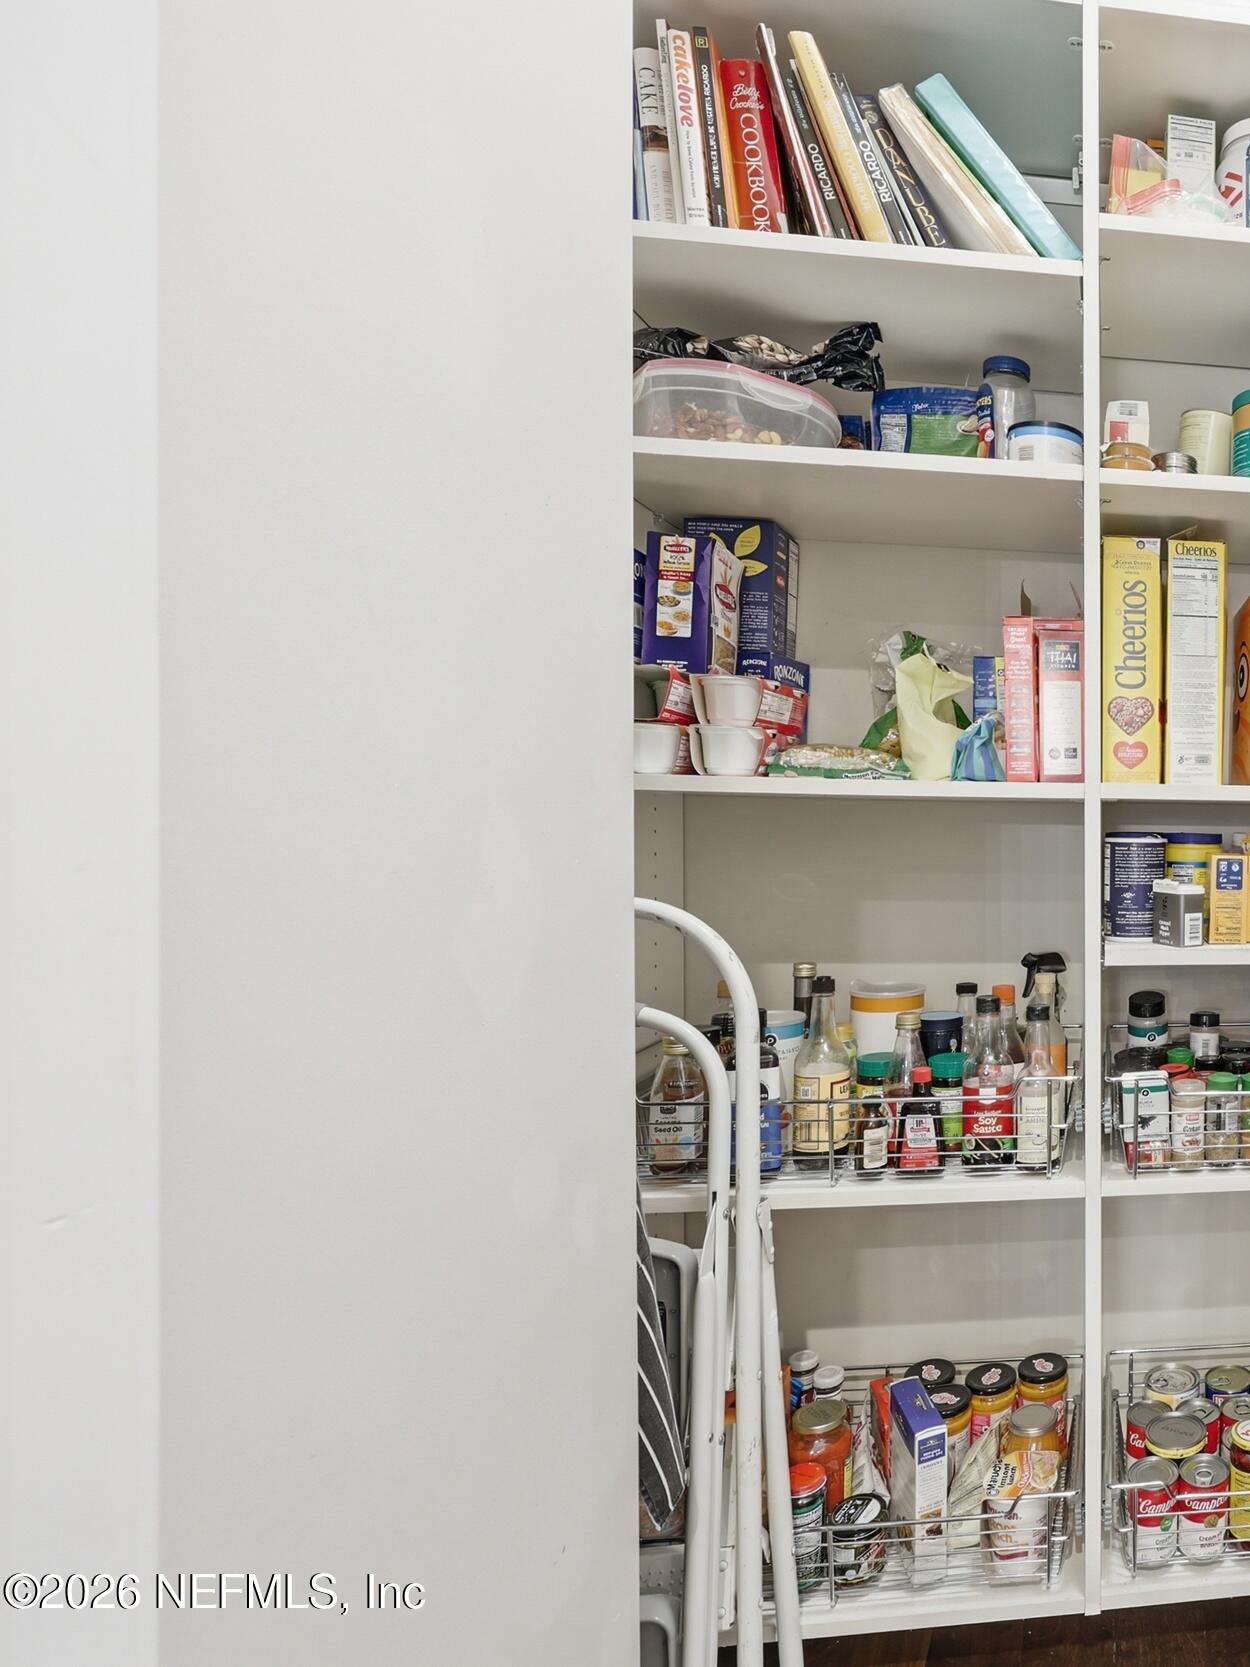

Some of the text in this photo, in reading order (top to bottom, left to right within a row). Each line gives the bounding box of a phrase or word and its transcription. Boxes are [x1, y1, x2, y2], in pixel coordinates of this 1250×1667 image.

[639, 67, 658, 115] CAKE
[671, 33, 695, 128] cakelove
[701, 64, 711, 96] RICARDO
[739, 112, 773, 232] COOKBOOK
[807, 142, 837, 201] RICARDO
[858, 140, 894, 203] RICARDO
[875, 128, 947, 248] DANUBE
[1174, 542, 1218, 558] Cheerios
[1047, 651, 1077, 664] THAI
[1114, 579, 1148, 690] Cheerios
[972, 1124, 1003, 1134] Sauce
[978, 1117, 998, 1126] Soy
